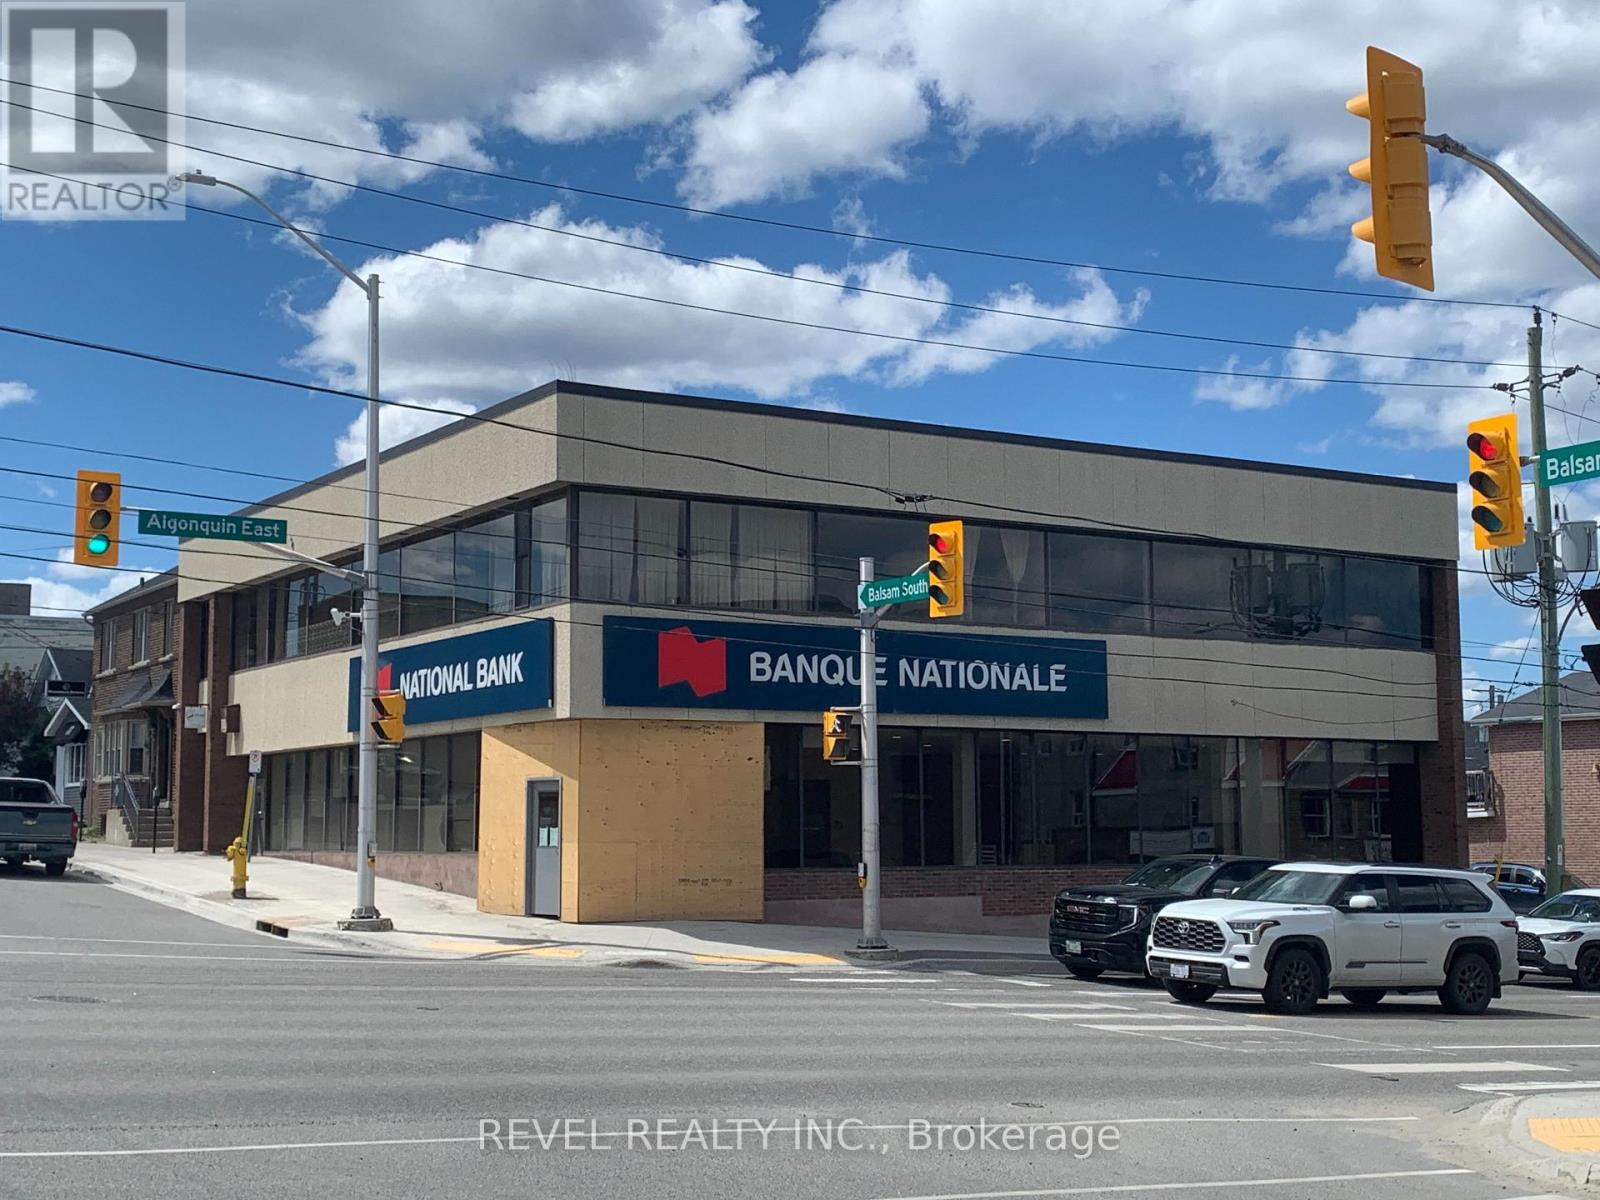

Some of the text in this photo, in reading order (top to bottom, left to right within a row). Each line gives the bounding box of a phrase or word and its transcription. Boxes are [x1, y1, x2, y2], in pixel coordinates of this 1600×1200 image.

[1546, 454, 1600, 480] Balsa
[146, 513, 280, 538] Algonquin East
[868, 579, 928, 602] Balsam South
[400, 651, 524, 700] NATIONAL BANK
[749, 651, 1067, 692] BANQUE NATIONALE
